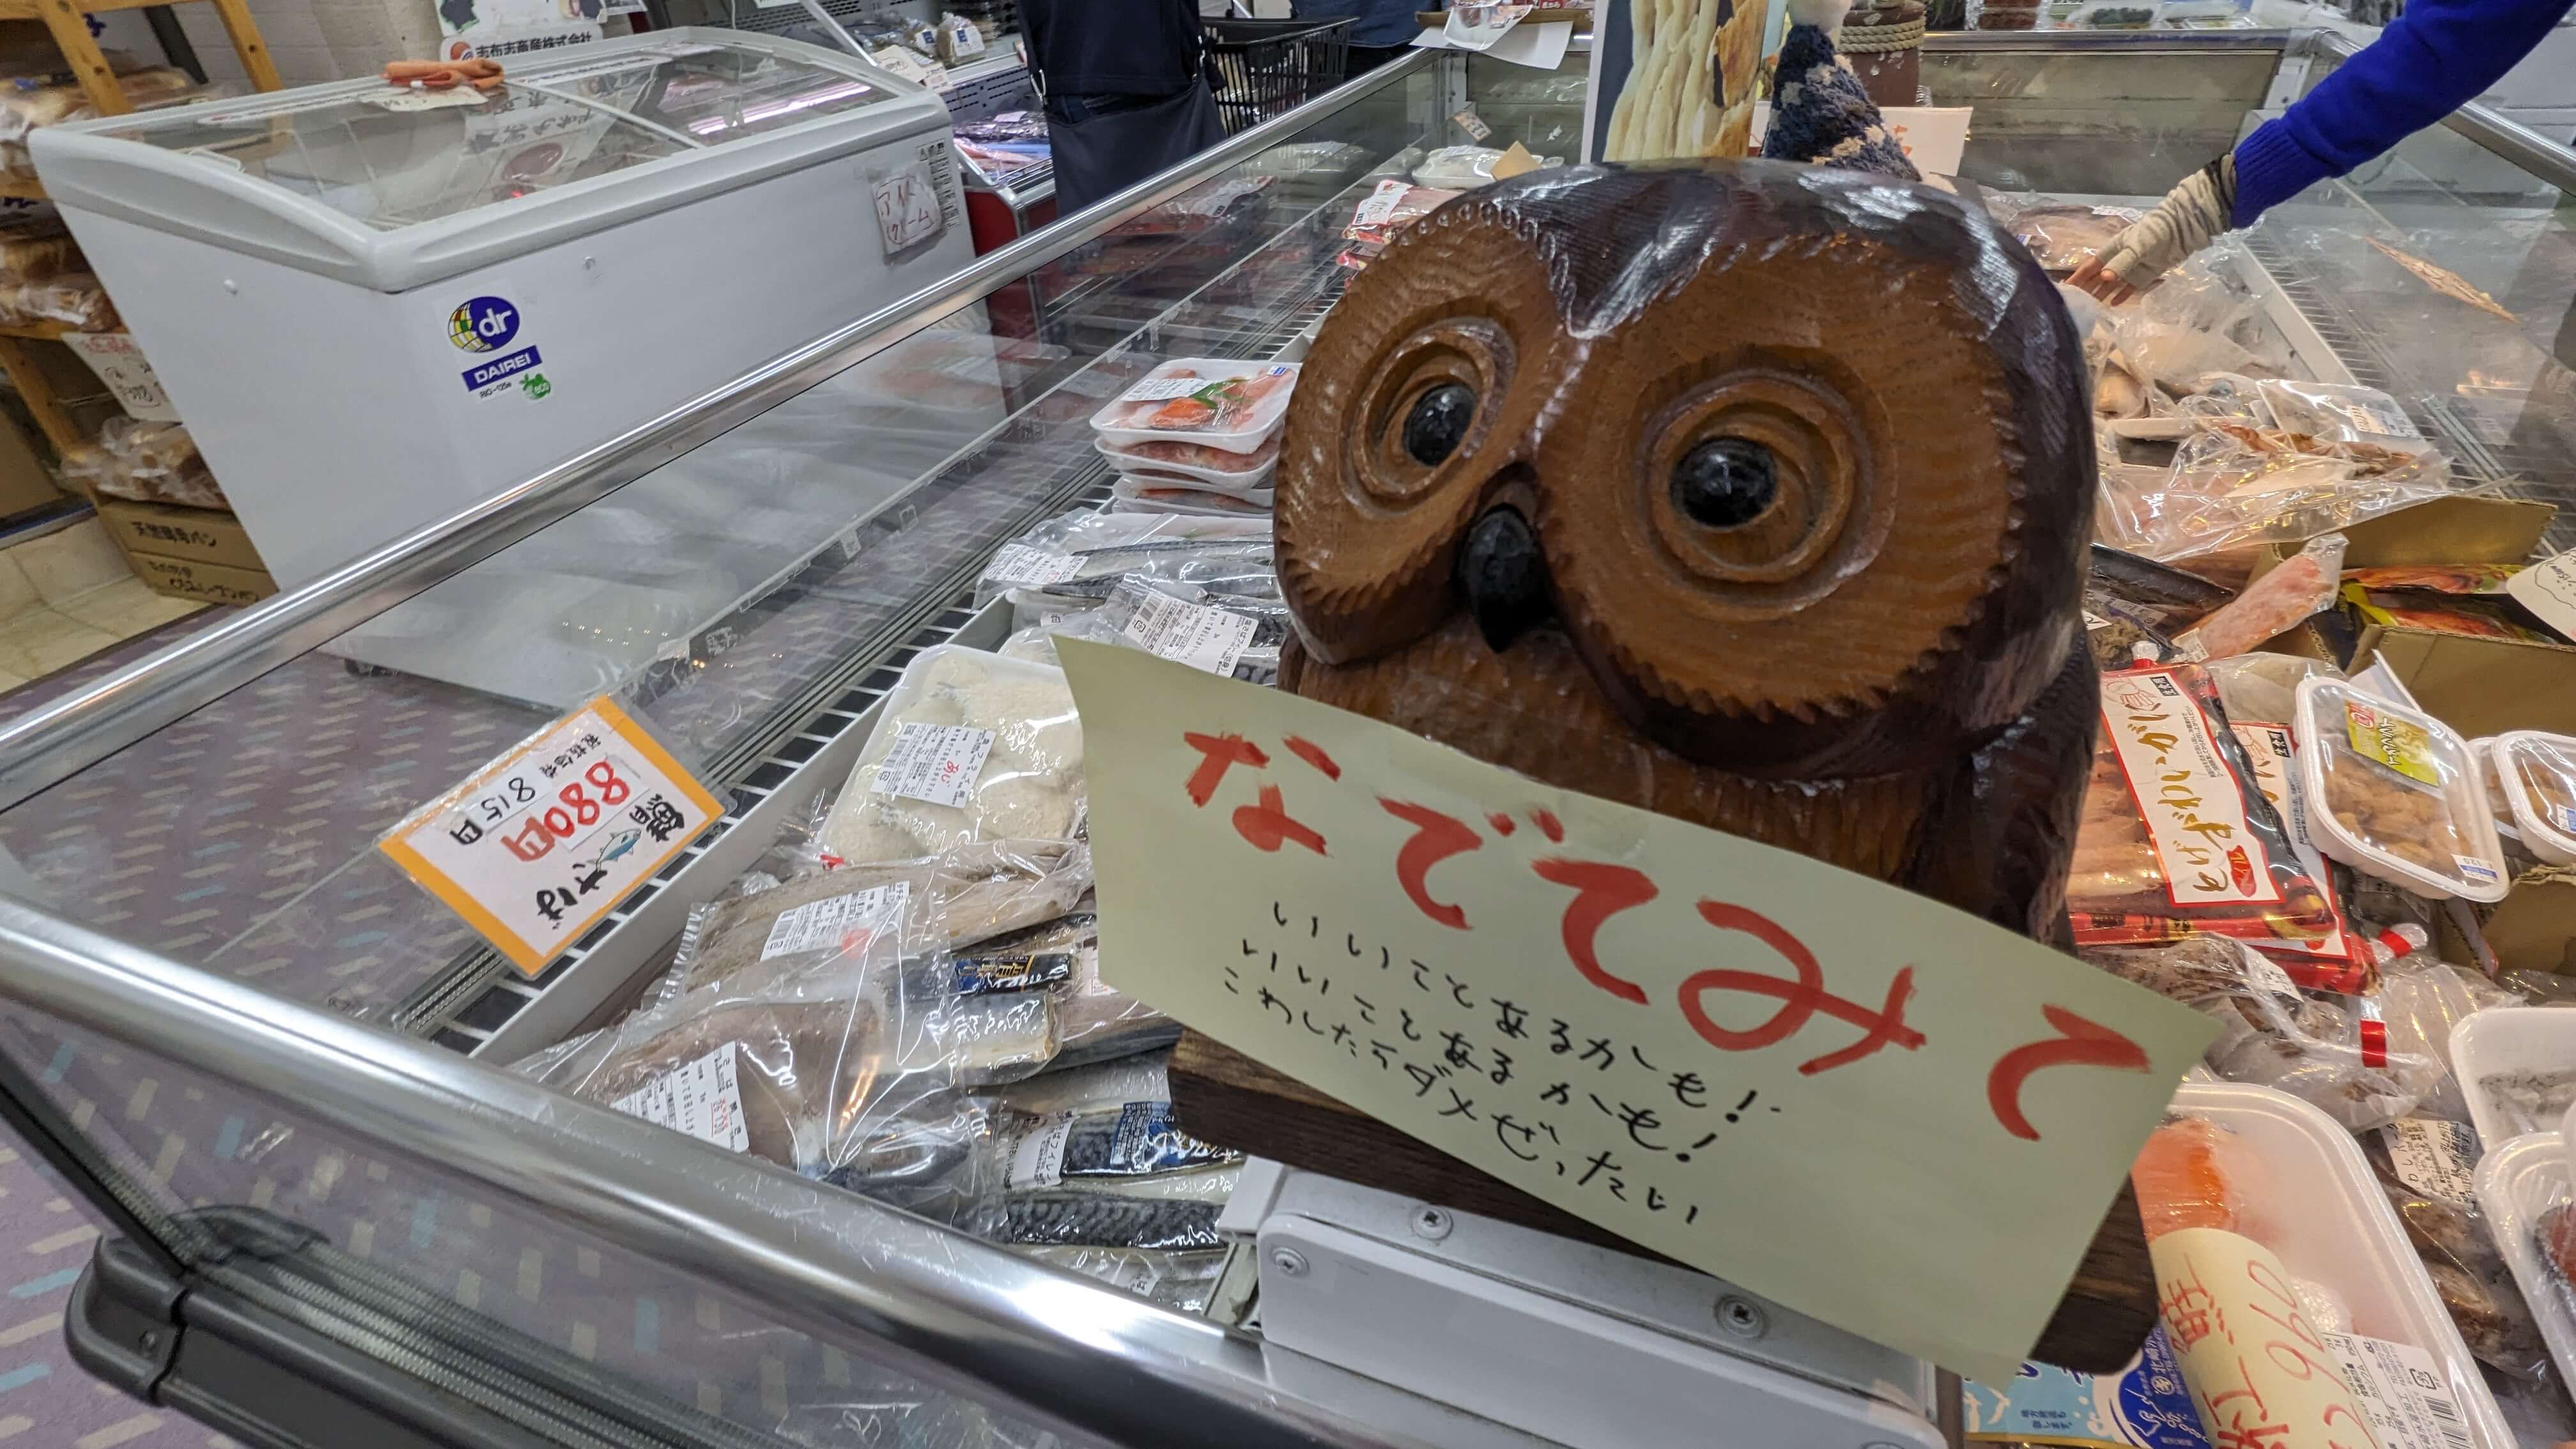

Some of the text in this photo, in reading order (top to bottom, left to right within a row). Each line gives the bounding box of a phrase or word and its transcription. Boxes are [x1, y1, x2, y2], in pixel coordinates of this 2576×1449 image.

[473, 353, 532, 383] DAIREI
[479, 307, 512, 337] dr
[449, 776, 536, 846] 815円
[500, 759, 631, 862] 880円
[940, 760, 960, 788] あじ
[536, 792, 685, 930] 鯖 さば
[1181, 730, 2152, 1142] なでてみて
[1242, 938, 1719, 1164] いいことあるかも!
[2247, 1259, 2379, 1449] 2960
